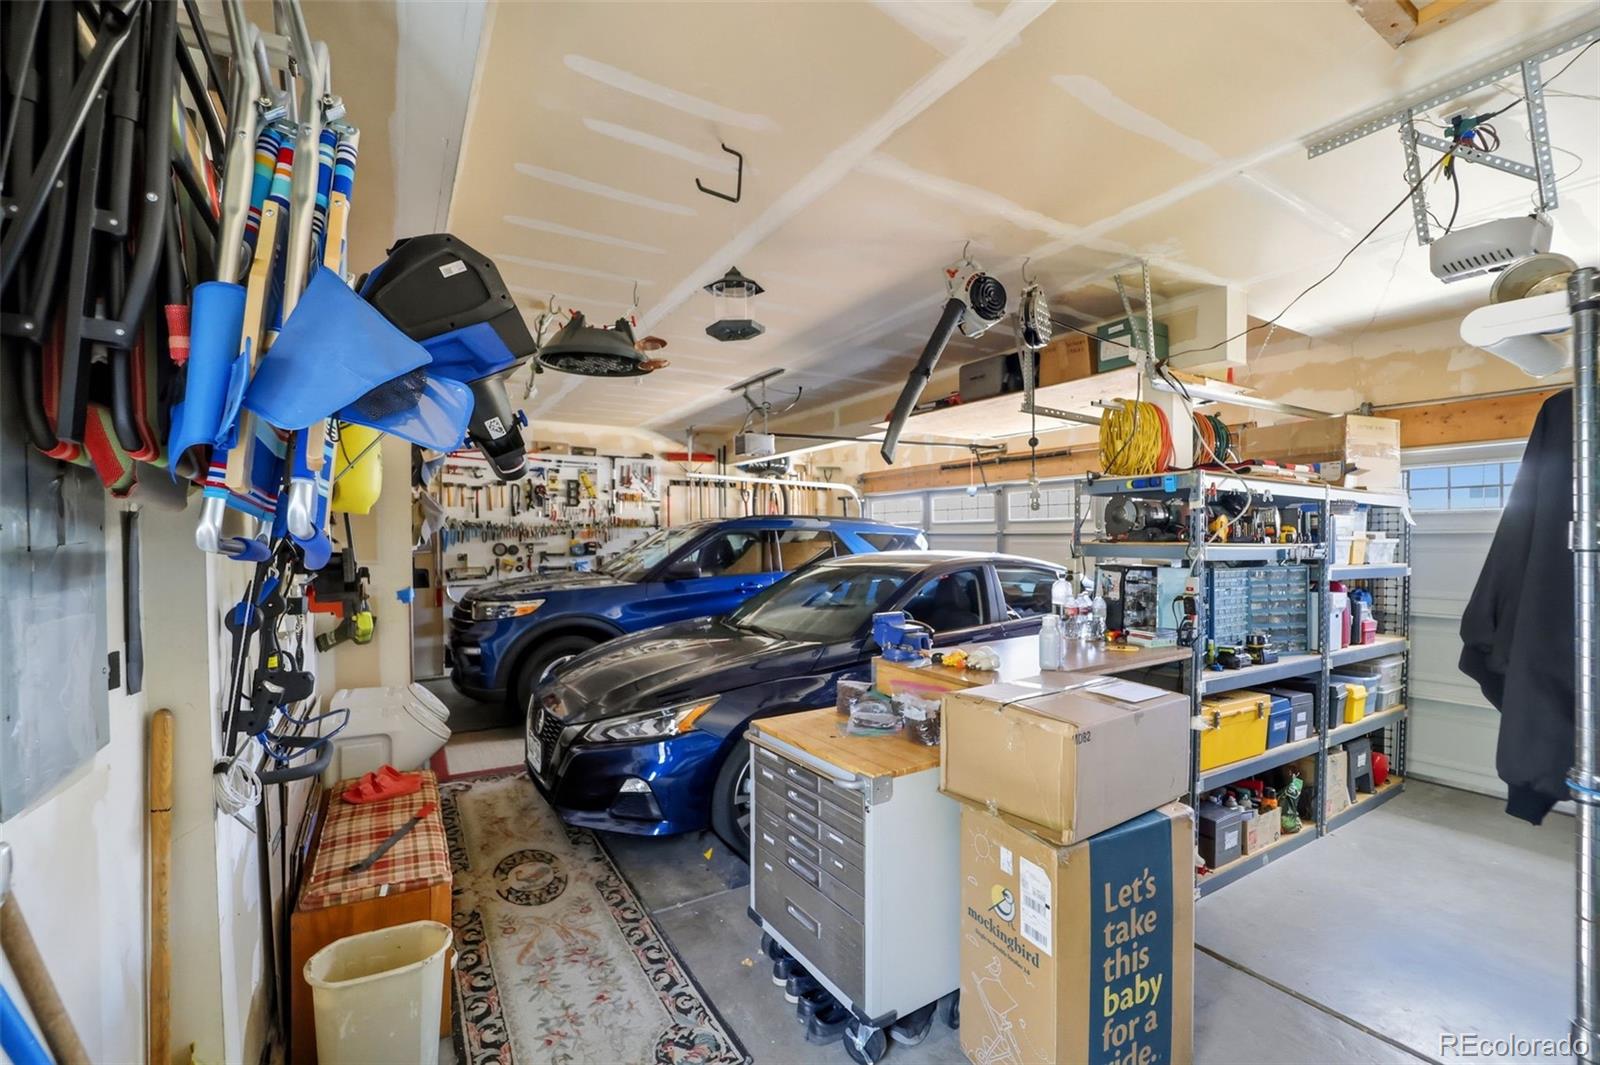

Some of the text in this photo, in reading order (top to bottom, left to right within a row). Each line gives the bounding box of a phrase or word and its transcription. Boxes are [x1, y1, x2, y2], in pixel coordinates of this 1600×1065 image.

[1104, 867, 1157, 913] Let's
[968, 906, 1039, 968] mockingbird
[1103, 907, 1157, 949] take
[1103, 941, 1150, 983] this
[1103, 972, 1163, 1017] baby
[1102, 1009, 1158, 1052] for a
[1104, 1041, 1157, 1065] ide.
